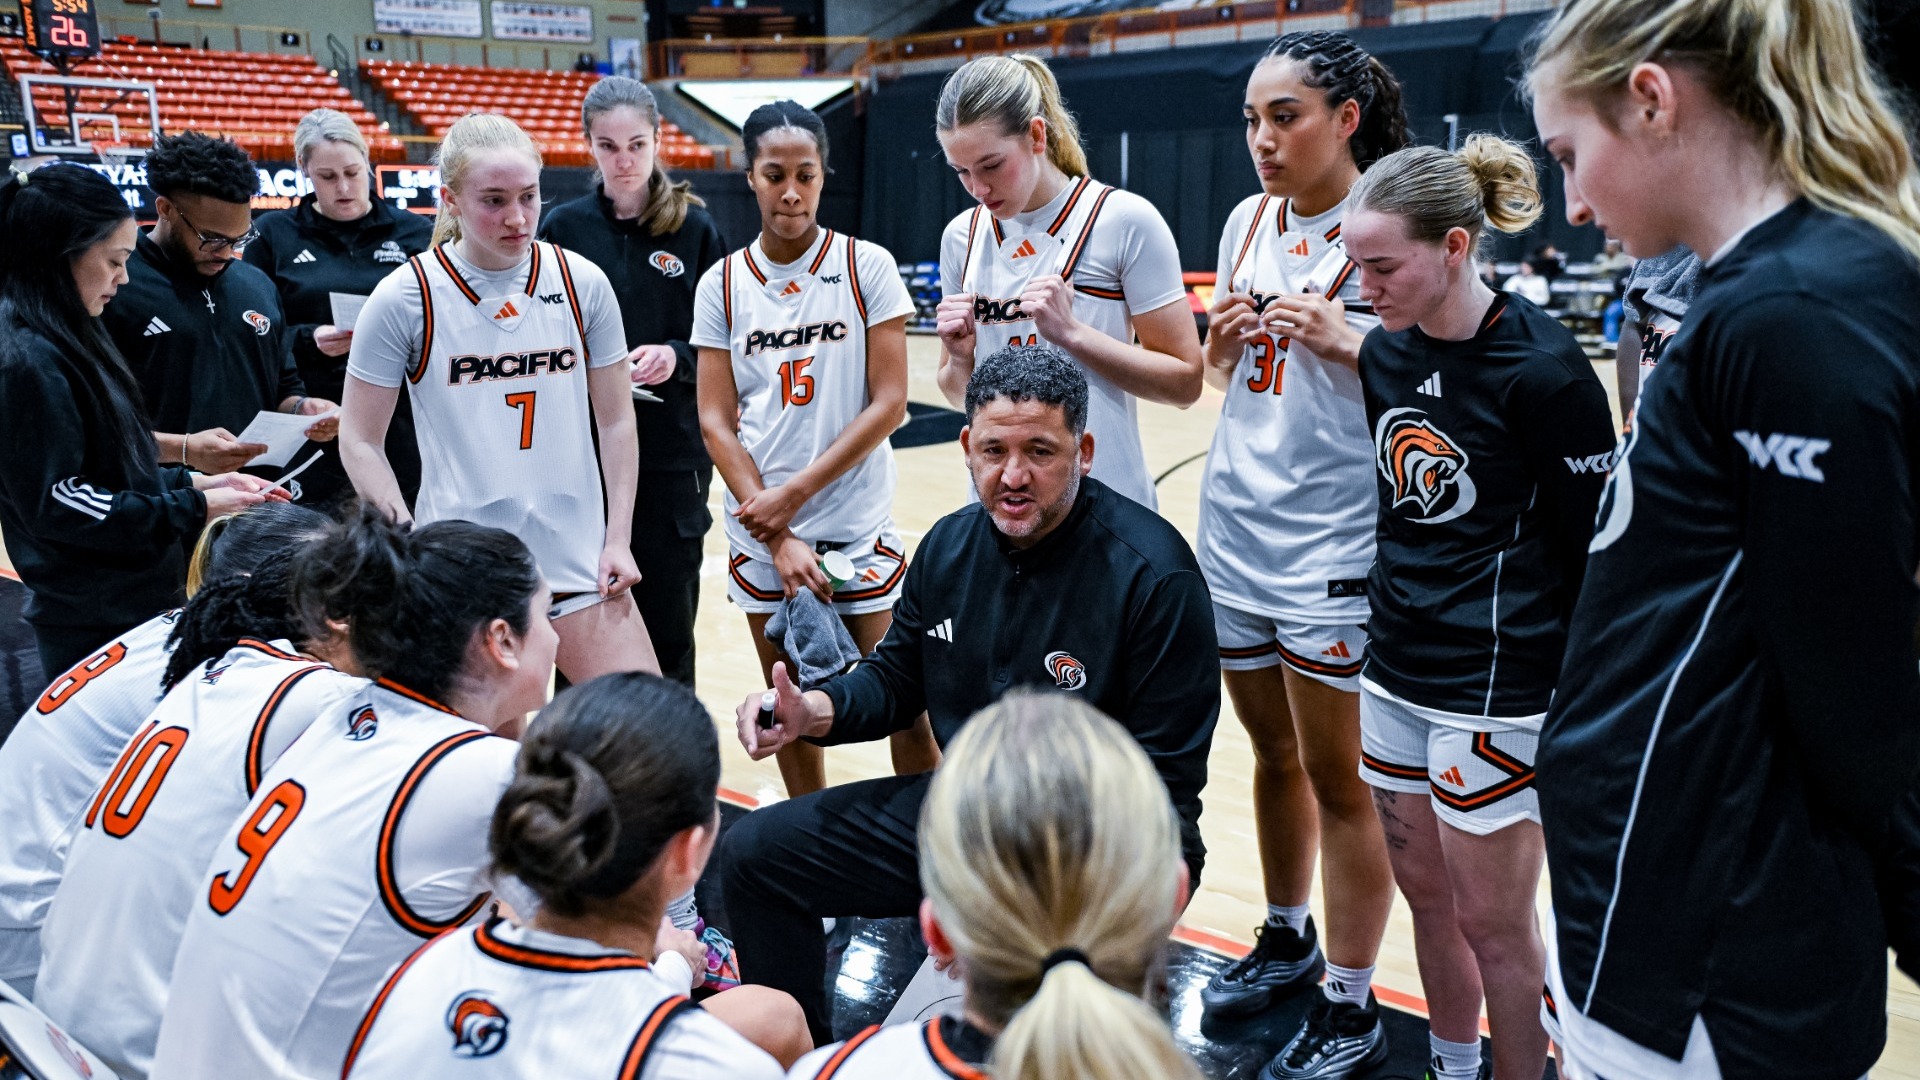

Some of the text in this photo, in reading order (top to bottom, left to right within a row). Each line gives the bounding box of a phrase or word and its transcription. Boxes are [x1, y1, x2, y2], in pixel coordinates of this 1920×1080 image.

[50, 15, 88, 47] 26
[820, 273, 842, 285] WCC
[539, 293, 565, 305] WCC
[973, 293, 1033, 325] PAC
[744, 320, 848, 358] PACIFIC
[448, 347, 578, 386] PACIFIC
[777, 356, 816, 411] 15
[505, 391, 537, 450] 7
[1563, 450, 1613, 474] WCC
[1733, 429, 1832, 483] WCC
[36, 641, 128, 715] 8
[85, 720, 190, 839] 10
[208, 778, 307, 916] 9
